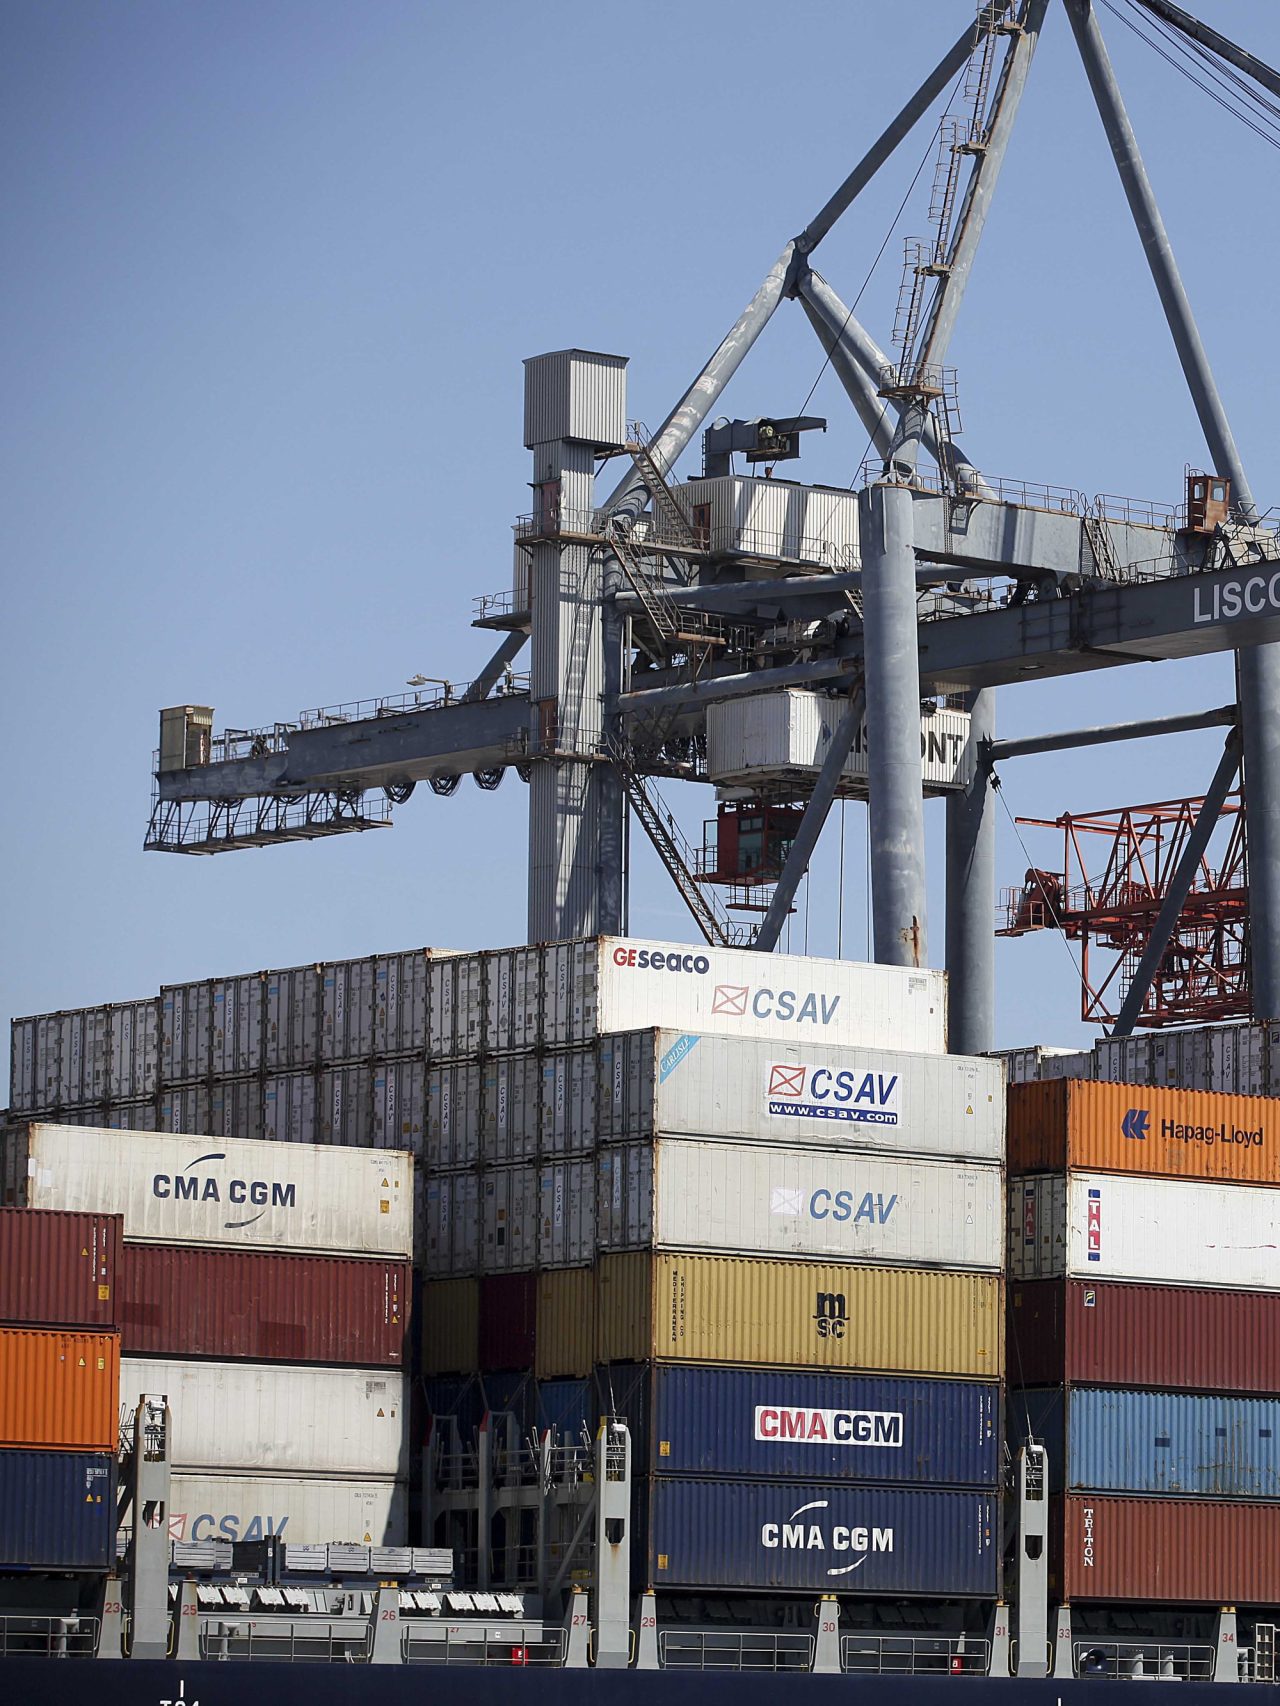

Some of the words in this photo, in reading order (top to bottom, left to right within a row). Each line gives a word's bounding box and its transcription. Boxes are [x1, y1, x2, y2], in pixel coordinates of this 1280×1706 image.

[613, 947, 710, 975] GEseaco
[752, 988, 841, 1026] CSAV
[661, 1037, 689, 1073] CARLISLE
[811, 1069, 897, 1106] CSAV
[770, 1104, 897, 1123] www.csav.com
[1161, 1118, 1263, 1147] Hapag-Lloyd
[153, 1172, 221, 1203] CMA
[229, 1178, 296, 1208] CGM
[809, 1189, 898, 1225] CSAV
[1089, 1202, 1099, 1249] TAL
[680, 1325, 684, 1337] CO
[759, 1408, 828, 1440] CMA
[833, 1413, 900, 1443] CGM
[191, 1514, 290, 1542] CSAV
[761, 1523, 825, 1550] CMA
[832, 1526, 894, 1552] CGM
[1083, 1508, 1094, 1567] TRITON
[105, 1602, 120, 1613] 23
[182, 1604, 197, 1616] 25
[381, 1610, 396, 1621] 26
[572, 1614, 587, 1626] 27
[641, 1615, 655, 1627] 29
[822, 1621, 835, 1632] 30
[995, 1626, 1006, 1636] 31
[1058, 1628, 1070, 1638] 33
[1222, 1633, 1234, 1643] 34
